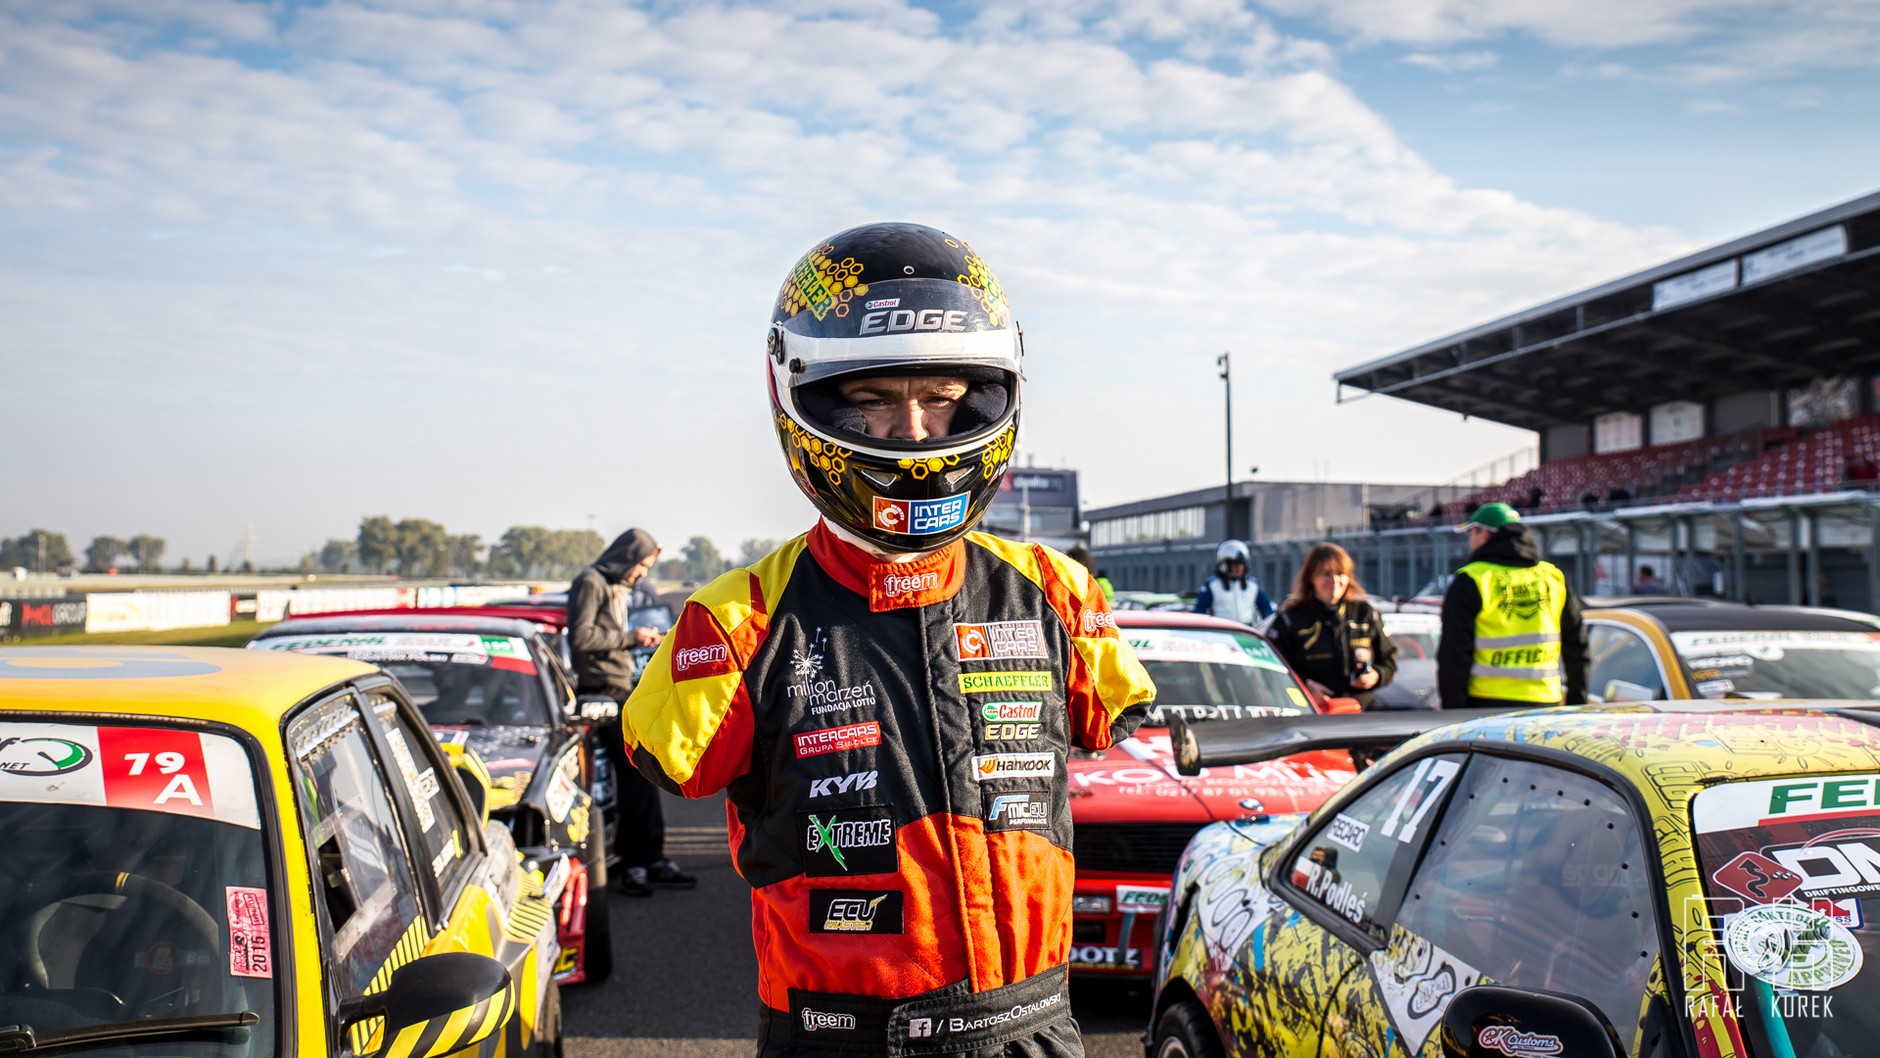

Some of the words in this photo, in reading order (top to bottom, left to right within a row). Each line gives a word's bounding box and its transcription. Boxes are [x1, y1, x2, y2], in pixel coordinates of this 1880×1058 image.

[795, 258, 834, 317] EFFLER
[873, 299, 897, 309] Castrol
[860, 309, 968, 335] EDGE
[914, 499, 962, 517] INTER
[914, 511, 960, 530] CARS
[884, 573, 938, 598] freem
[1083, 609, 1114, 632] free
[992, 626, 1036, 640] INTER
[676, 643, 728, 671] freem
[994, 640, 1038, 653] CARS
[787, 679, 836, 698] milion
[809, 680, 875, 706] marzeń
[963, 675, 1050, 689] SCHAEFFLER
[811, 700, 852, 716] FUNDACJA
[852, 696, 876, 707] LOTTO
[999, 703, 1038, 719] Castrol
[797, 724, 878, 747] INTERCARS
[985, 723, 1042, 740] EDGE
[799, 744, 834, 755] GRUPA
[123, 751, 186, 776] 79
[153, 774, 204, 806] A
[809, 770, 878, 799] KYB
[1380, 757, 1461, 844] 17
[1768, 779, 1880, 815] FE
[807, 815, 892, 871] EXTREME
[1333, 817, 1367, 847] RECARO
[1305, 864, 1367, 924] R.Podleś
[827, 897, 882, 920] ECU
[823, 919, 873, 931] MASTER
[251, 936, 267, 973] 2015
[802, 1007, 856, 1031] freem
[1507, 1034, 1556, 1048] Customs
